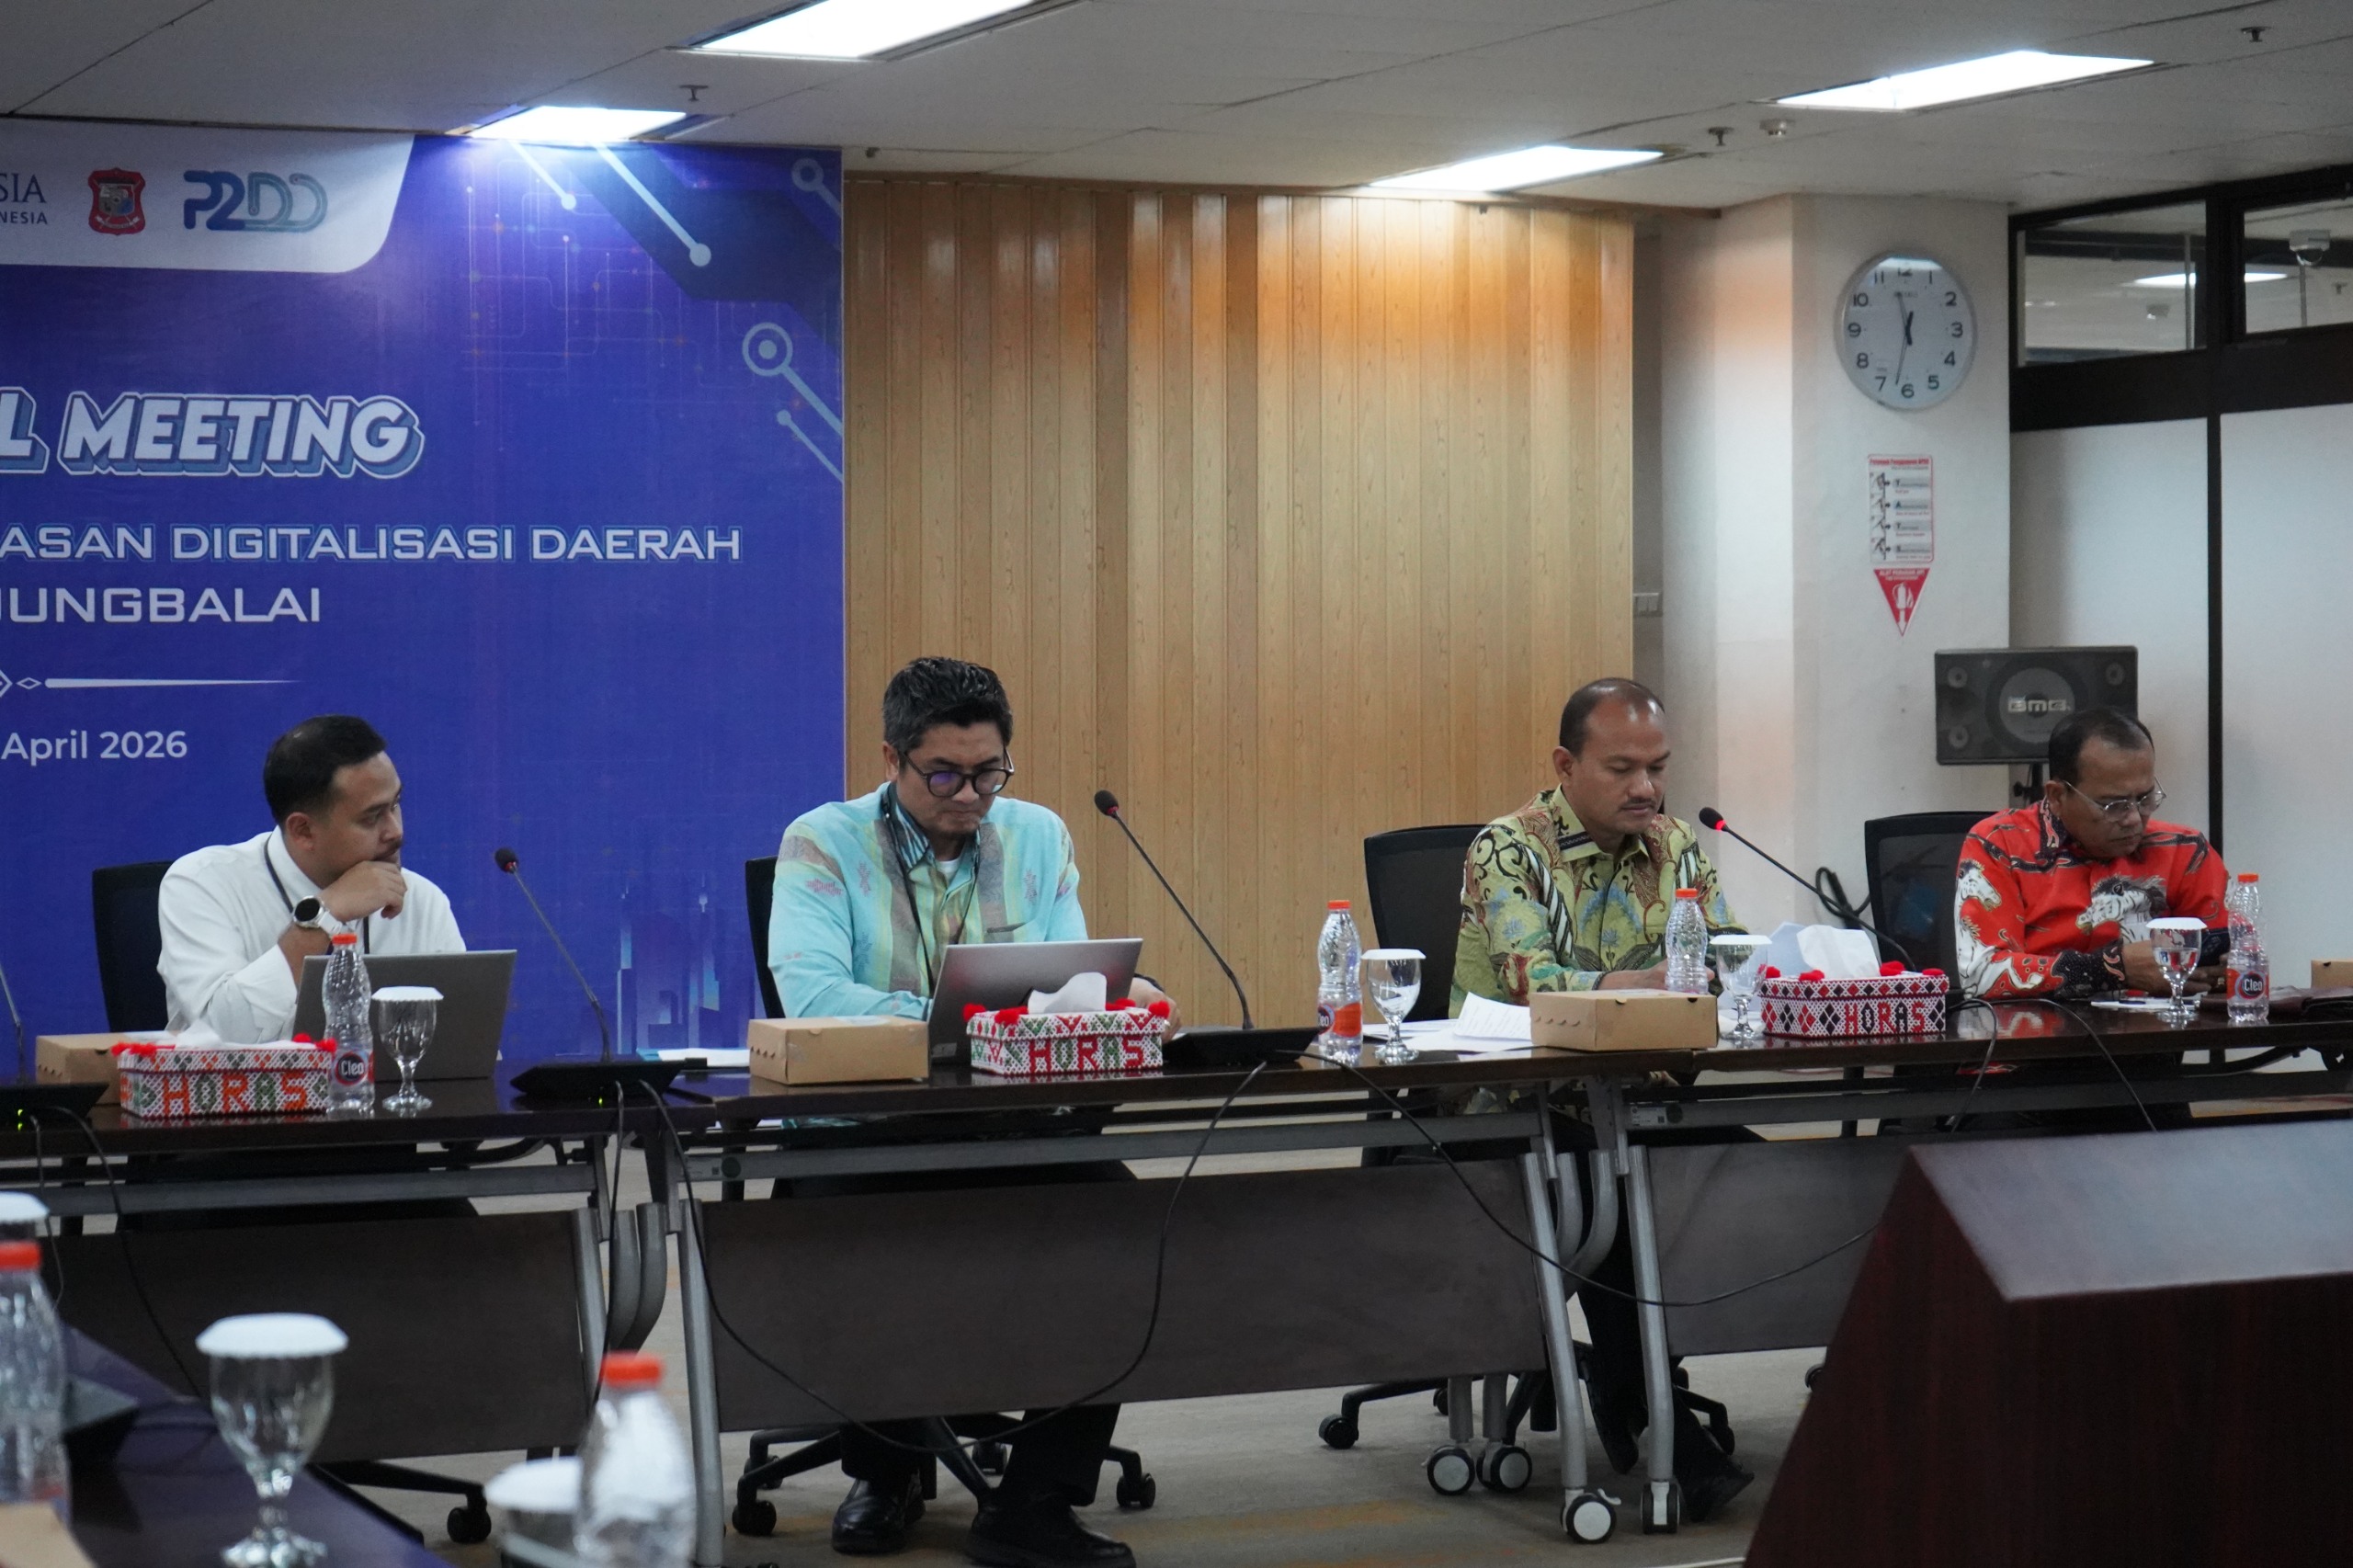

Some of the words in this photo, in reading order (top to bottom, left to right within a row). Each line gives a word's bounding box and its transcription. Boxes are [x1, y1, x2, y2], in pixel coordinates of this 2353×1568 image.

[1853, 292, 1869, 307] 10
[1945, 291, 1957, 306] 2
[1847, 323, 1862, 338] 9
[1951, 322, 1963, 338] 3
[1857, 352, 1869, 369] 8
[1944, 350, 1956, 367] 4
[1875, 376, 1887, 392] 7
[1901, 383, 1915, 398] 6
[1927, 375, 1939, 390] 5
[0, 390, 42, 467] L
[60, 392, 419, 474] MEETING
[0, 527, 153, 559] ASAN
[173, 527, 512, 560] DIGITALISASI
[532, 528, 740, 560] DAERAH
[0, 587, 321, 622] UNGBALAI
[1, 731, 88, 767] April
[99, 731, 188, 759] 2026
[2244, 978, 2263, 992] Cleo
[1844, 1000, 1926, 1035] HORAS
[340, 1060, 366, 1075] Cleo
